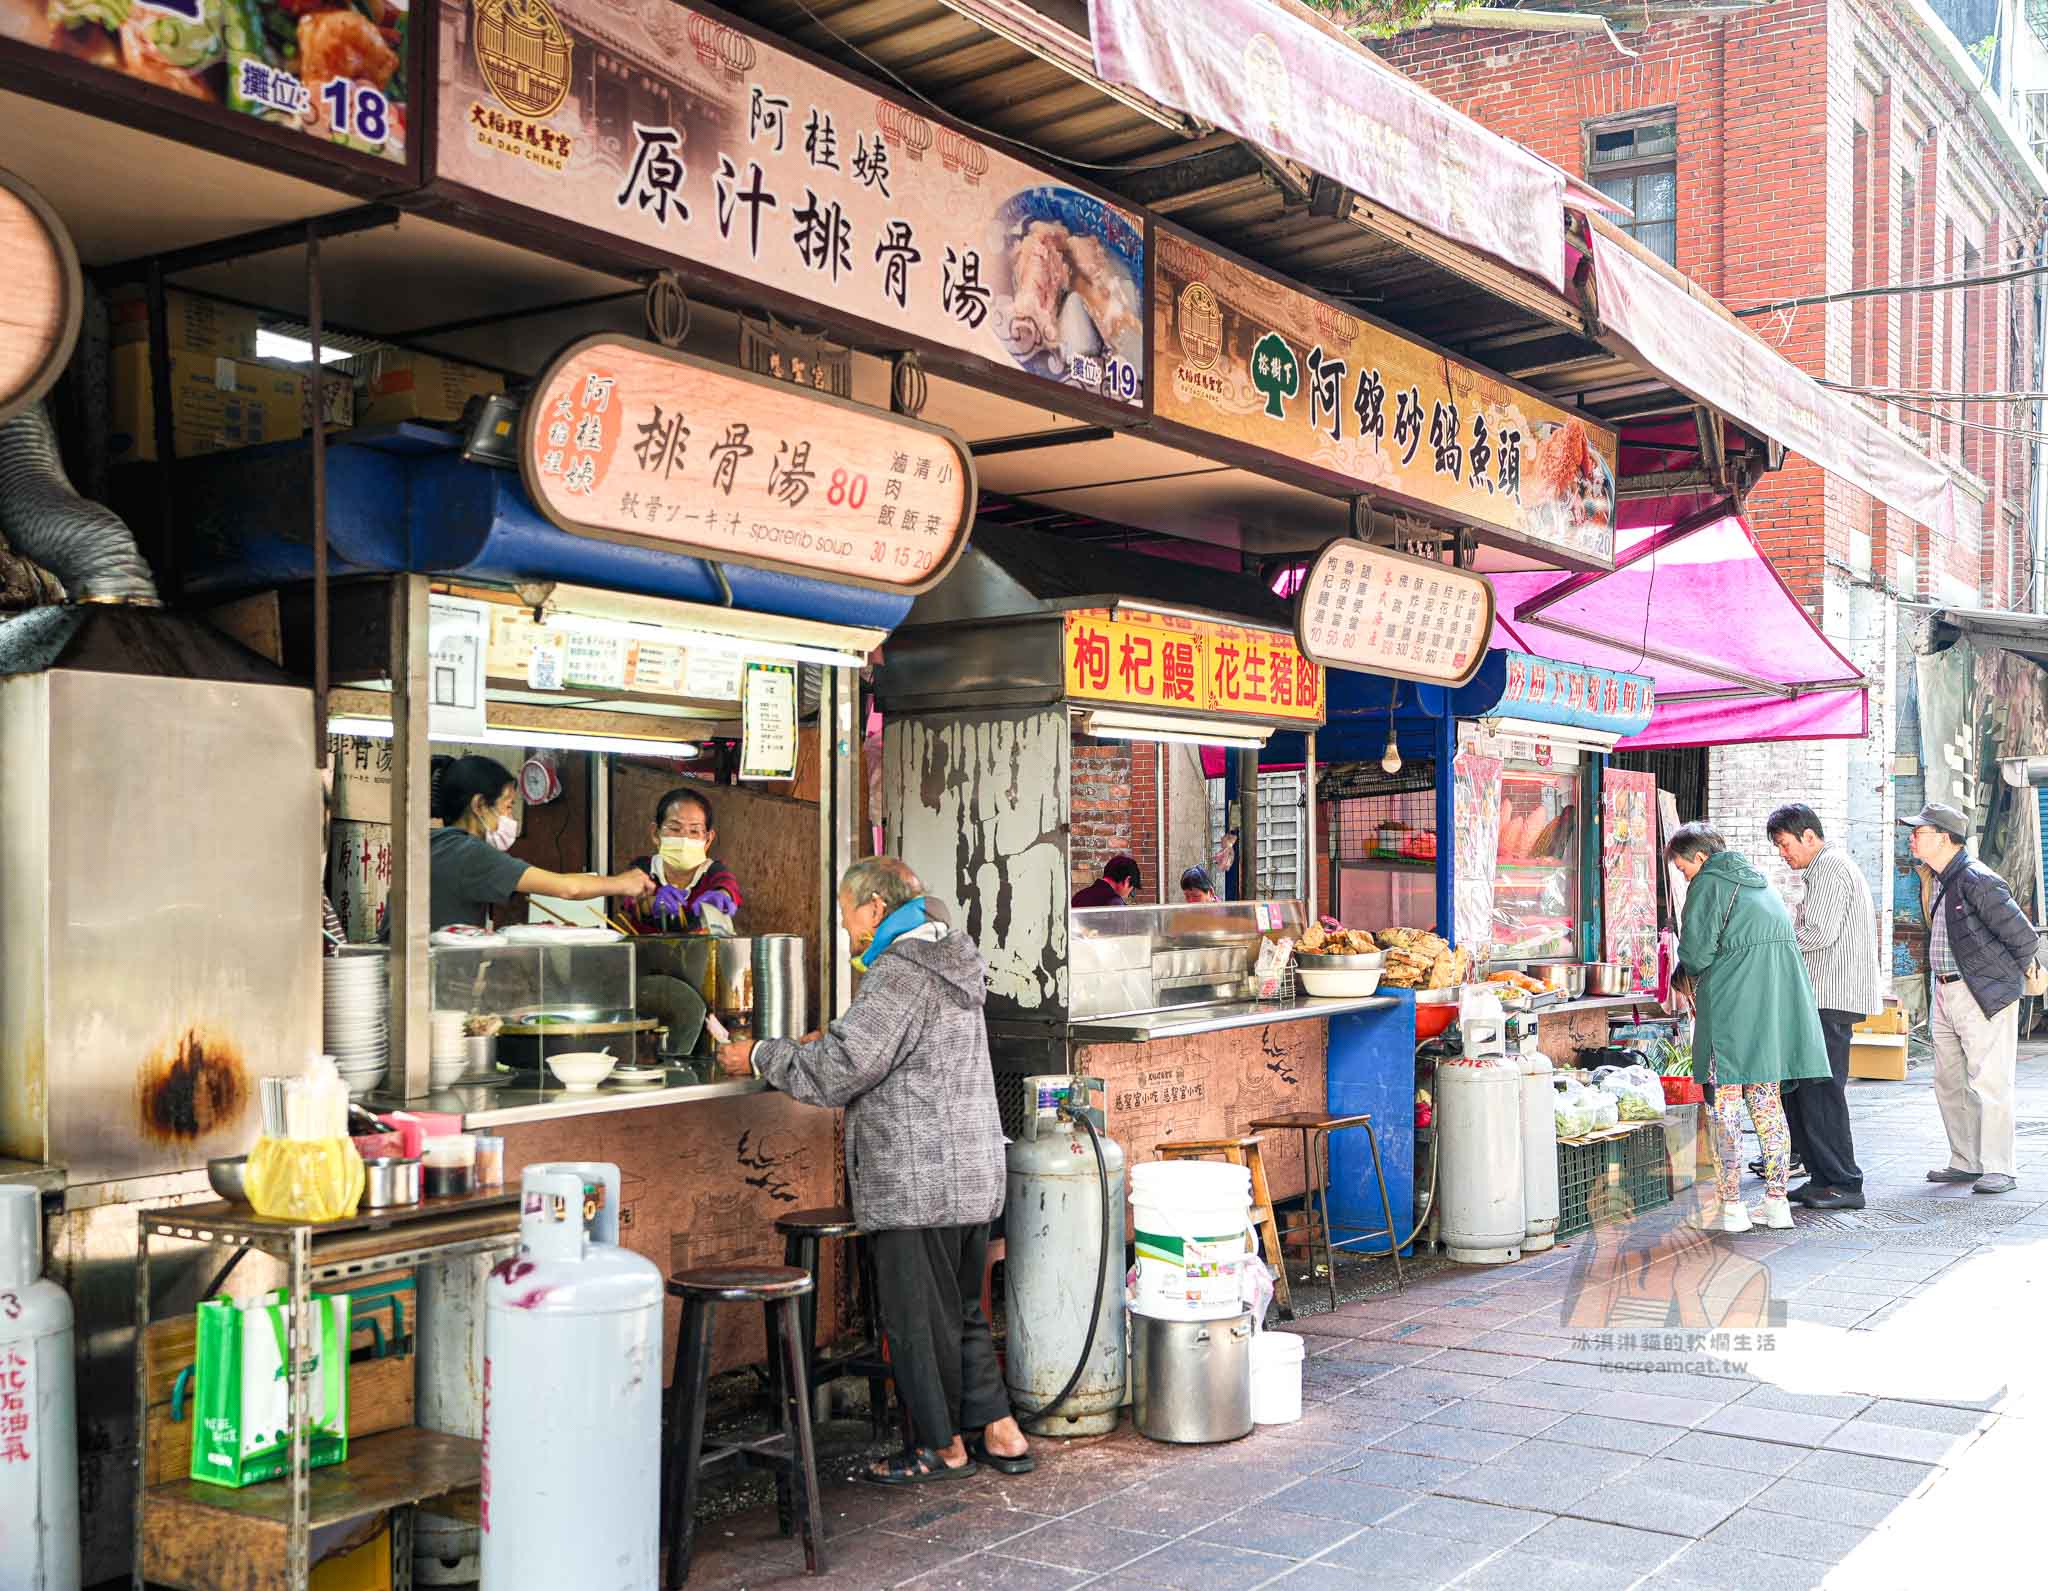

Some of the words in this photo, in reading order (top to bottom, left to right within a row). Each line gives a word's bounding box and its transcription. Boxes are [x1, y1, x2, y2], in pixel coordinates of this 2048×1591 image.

[323, 80, 388, 142] 18
[750, 87, 890, 198] 阿桂姨
[618, 122, 991, 329] 原汁排骨湯
[1106, 360, 1136, 398] 19
[1257, 351, 1293, 385] 榕樹下
[1306, 348, 1522, 504] 阿錦砂鍋魚頭
[633, 405, 817, 508] 排骨湯
[826, 467, 870, 511] 80
[748, 521, 813, 551] sparerib
[816, 533, 853, 557] soup
[870, 540, 886, 562] 30
[894, 545, 910, 567] 15
[914, 549, 933, 571] 20
[1073, 625, 1195, 703] 枸杞鰻
[1215, 642, 1318, 708] 花生豬腳
